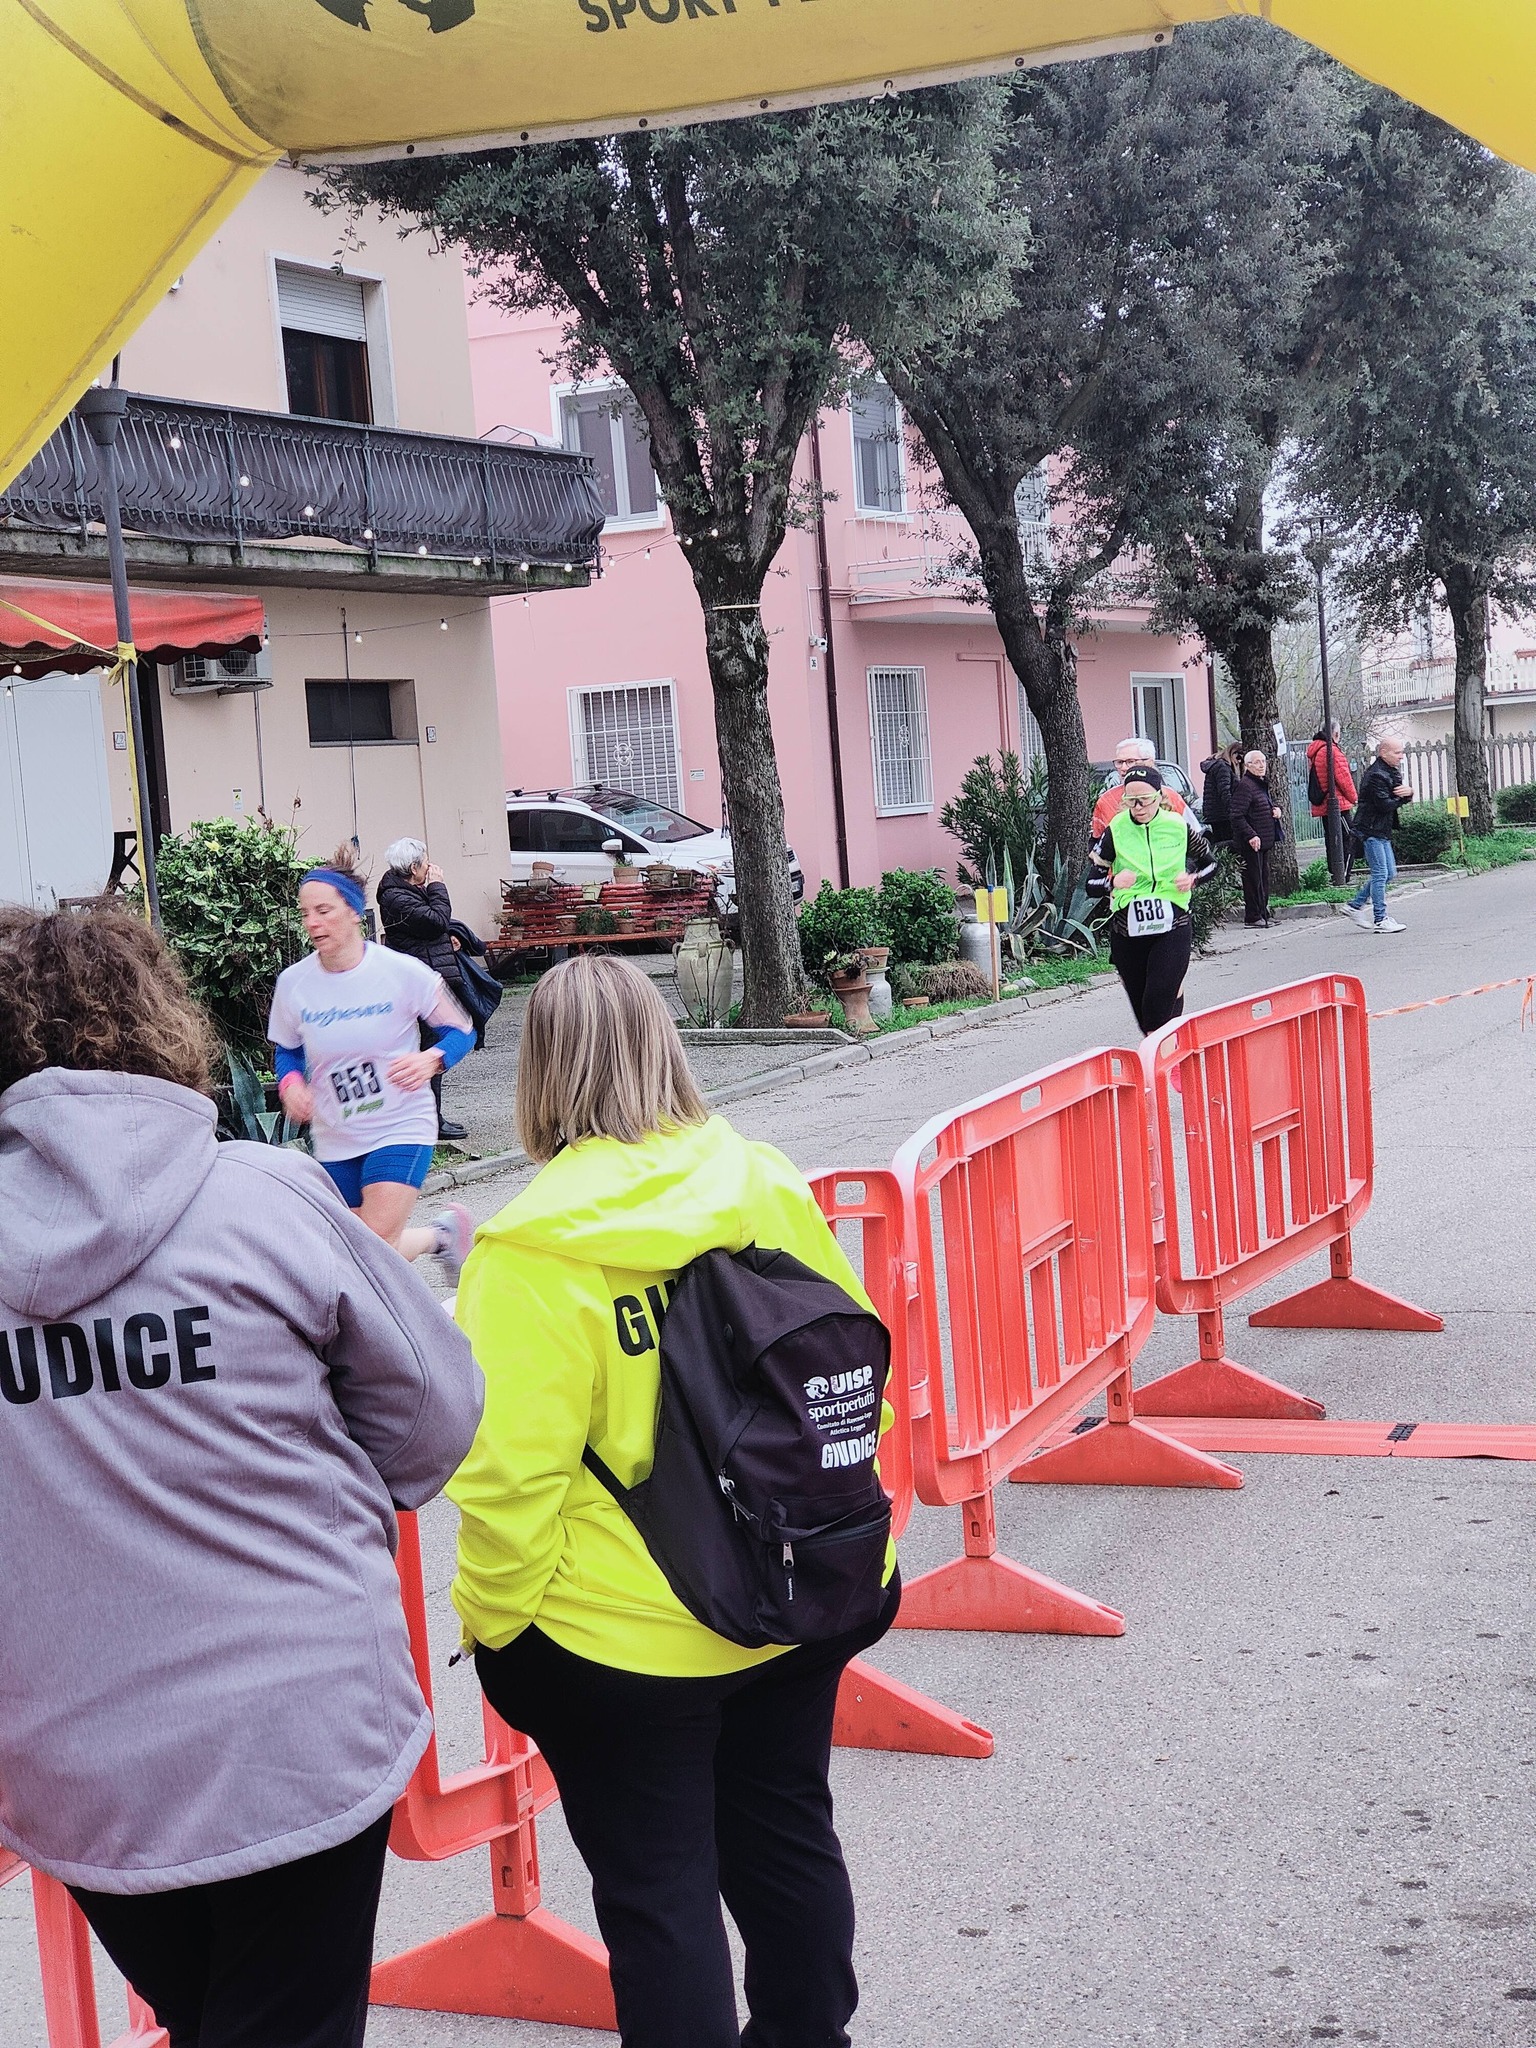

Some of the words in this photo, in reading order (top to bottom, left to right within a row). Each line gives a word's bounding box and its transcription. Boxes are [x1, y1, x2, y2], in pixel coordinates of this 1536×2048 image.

[1133, 898, 1165, 922] 638
[331, 1061, 382, 1103] 653
[0, 1305, 216, 1404] UDICE
[807, 1388, 875, 1423] sportpertutti
[816, 1421, 840, 1430] Comitato
[829, 1427, 850, 1436] Atletica
[821, 1429, 877, 1469] GIUDICE
